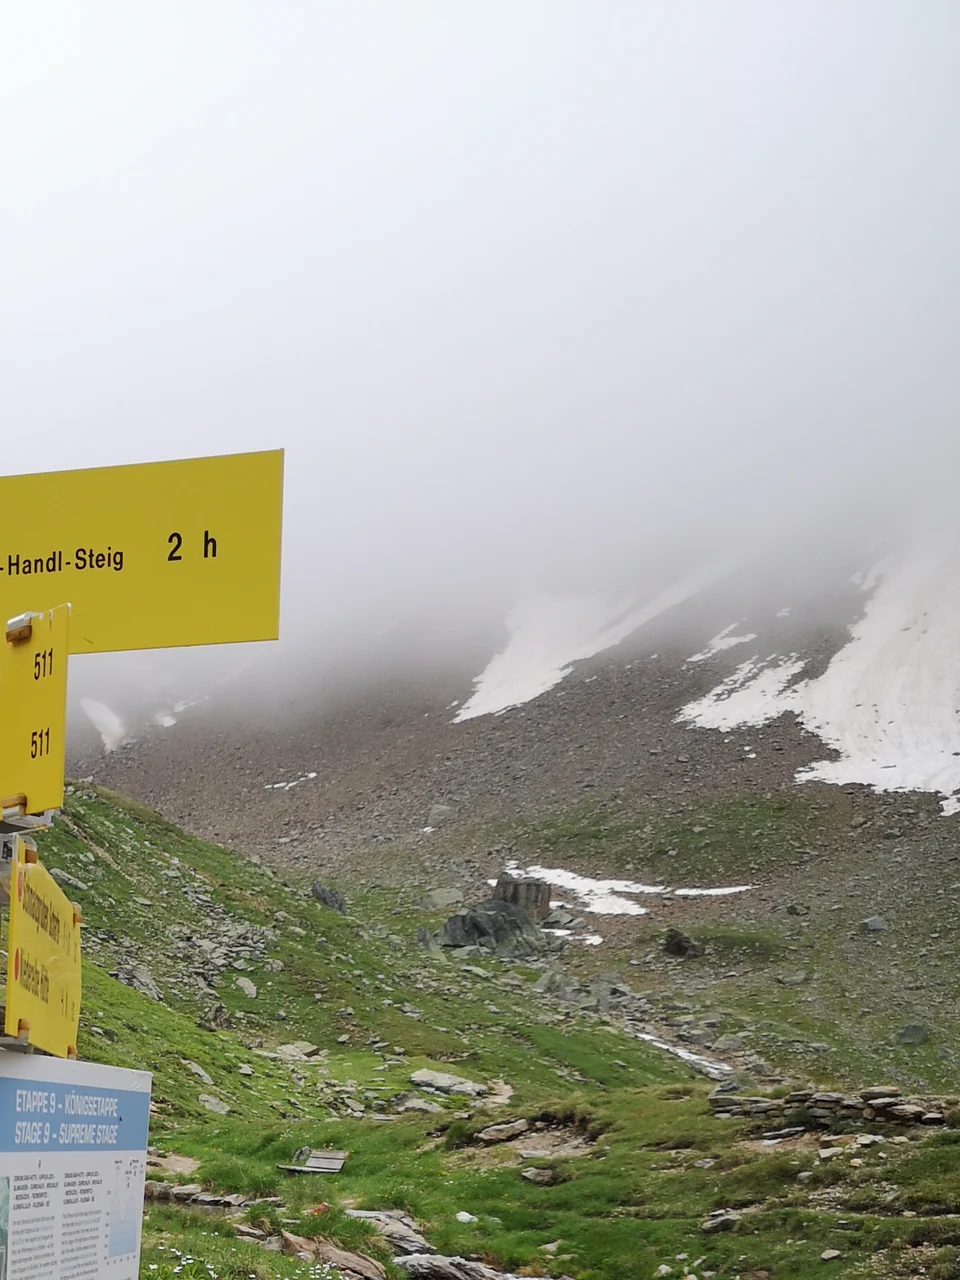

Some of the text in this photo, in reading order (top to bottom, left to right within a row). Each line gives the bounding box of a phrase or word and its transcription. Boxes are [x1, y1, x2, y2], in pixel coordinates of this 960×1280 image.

[167, 530, 218, 562] 2 h
[33, 648, 54, 682] 511
[30, 727, 51, 760] 511
[15, 1089, 49, 1114] ETAPPE
[49, 1092, 56, 1114] 9
[64, 1090, 118, 1117] KÖNIGSETAPPE
[15, 1121, 43, 1144] STAGE
[43, 1122, 50, 1144] 9
[59, 1123, 95, 1144] SUPREME
[96, 1124, 118, 1144] STAGE
